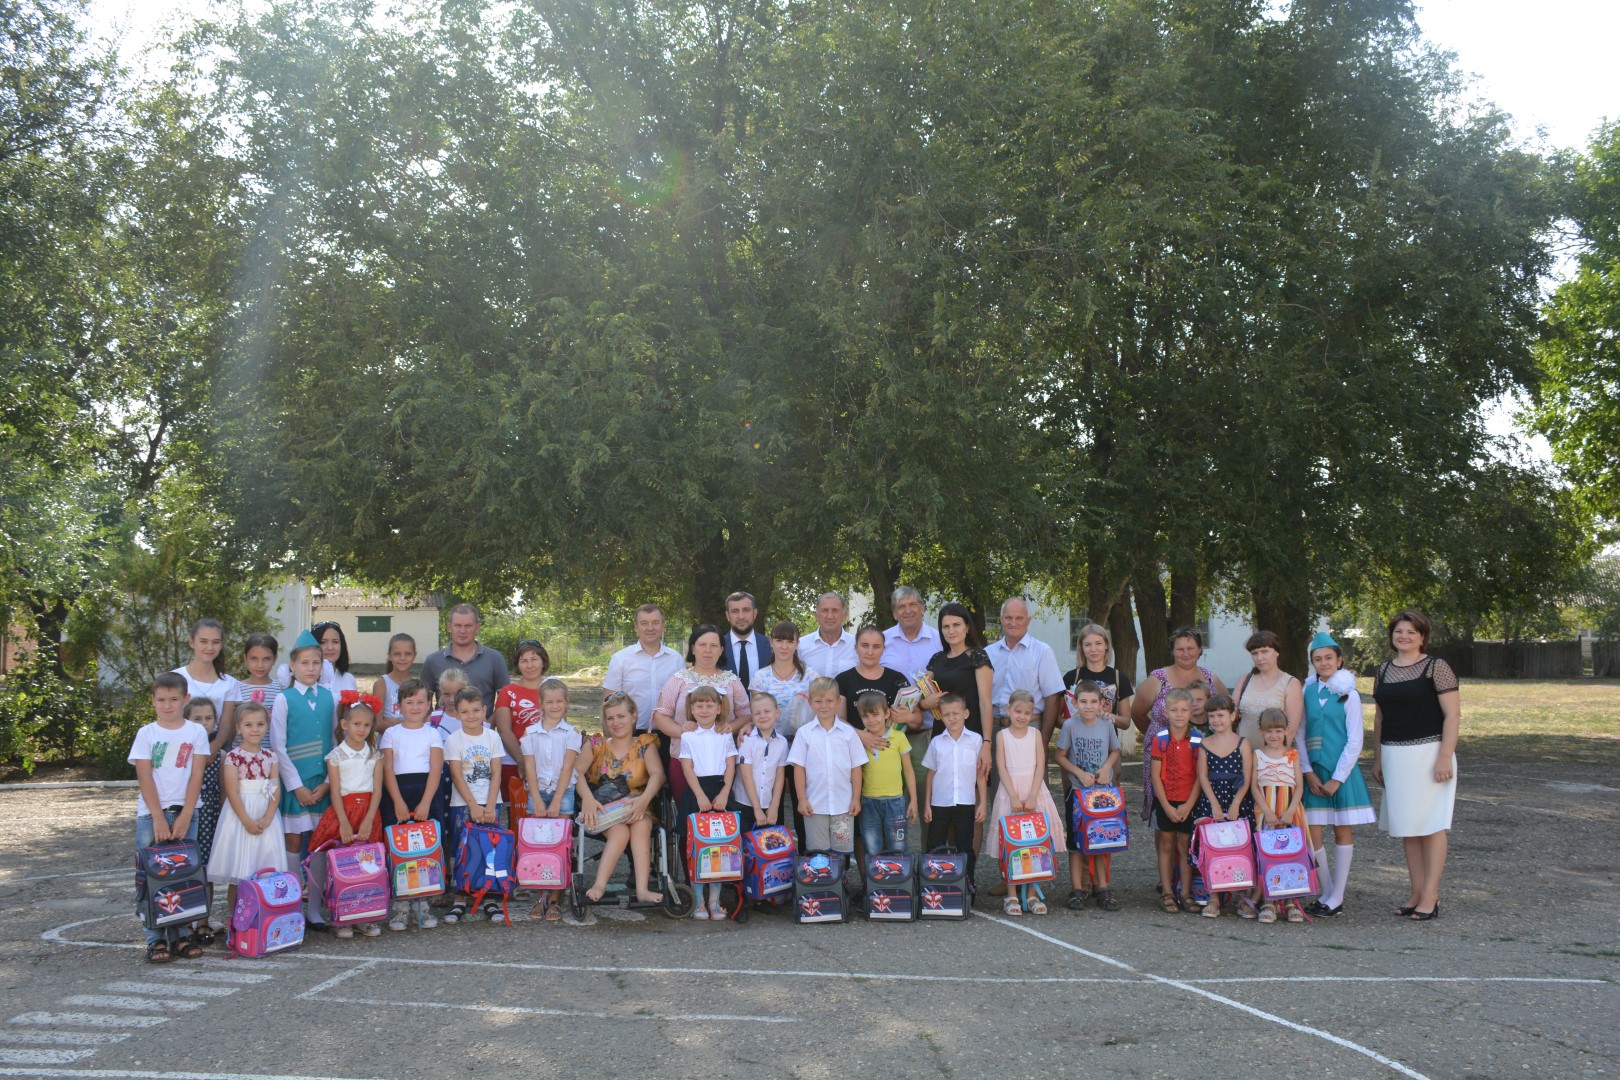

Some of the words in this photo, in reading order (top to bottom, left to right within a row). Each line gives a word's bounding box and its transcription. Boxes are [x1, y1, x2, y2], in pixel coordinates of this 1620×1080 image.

[1075, 737, 1103, 749] SURF
[1076, 750, 1102, 762] RIDER
[896, 828, 905, 841] 6
